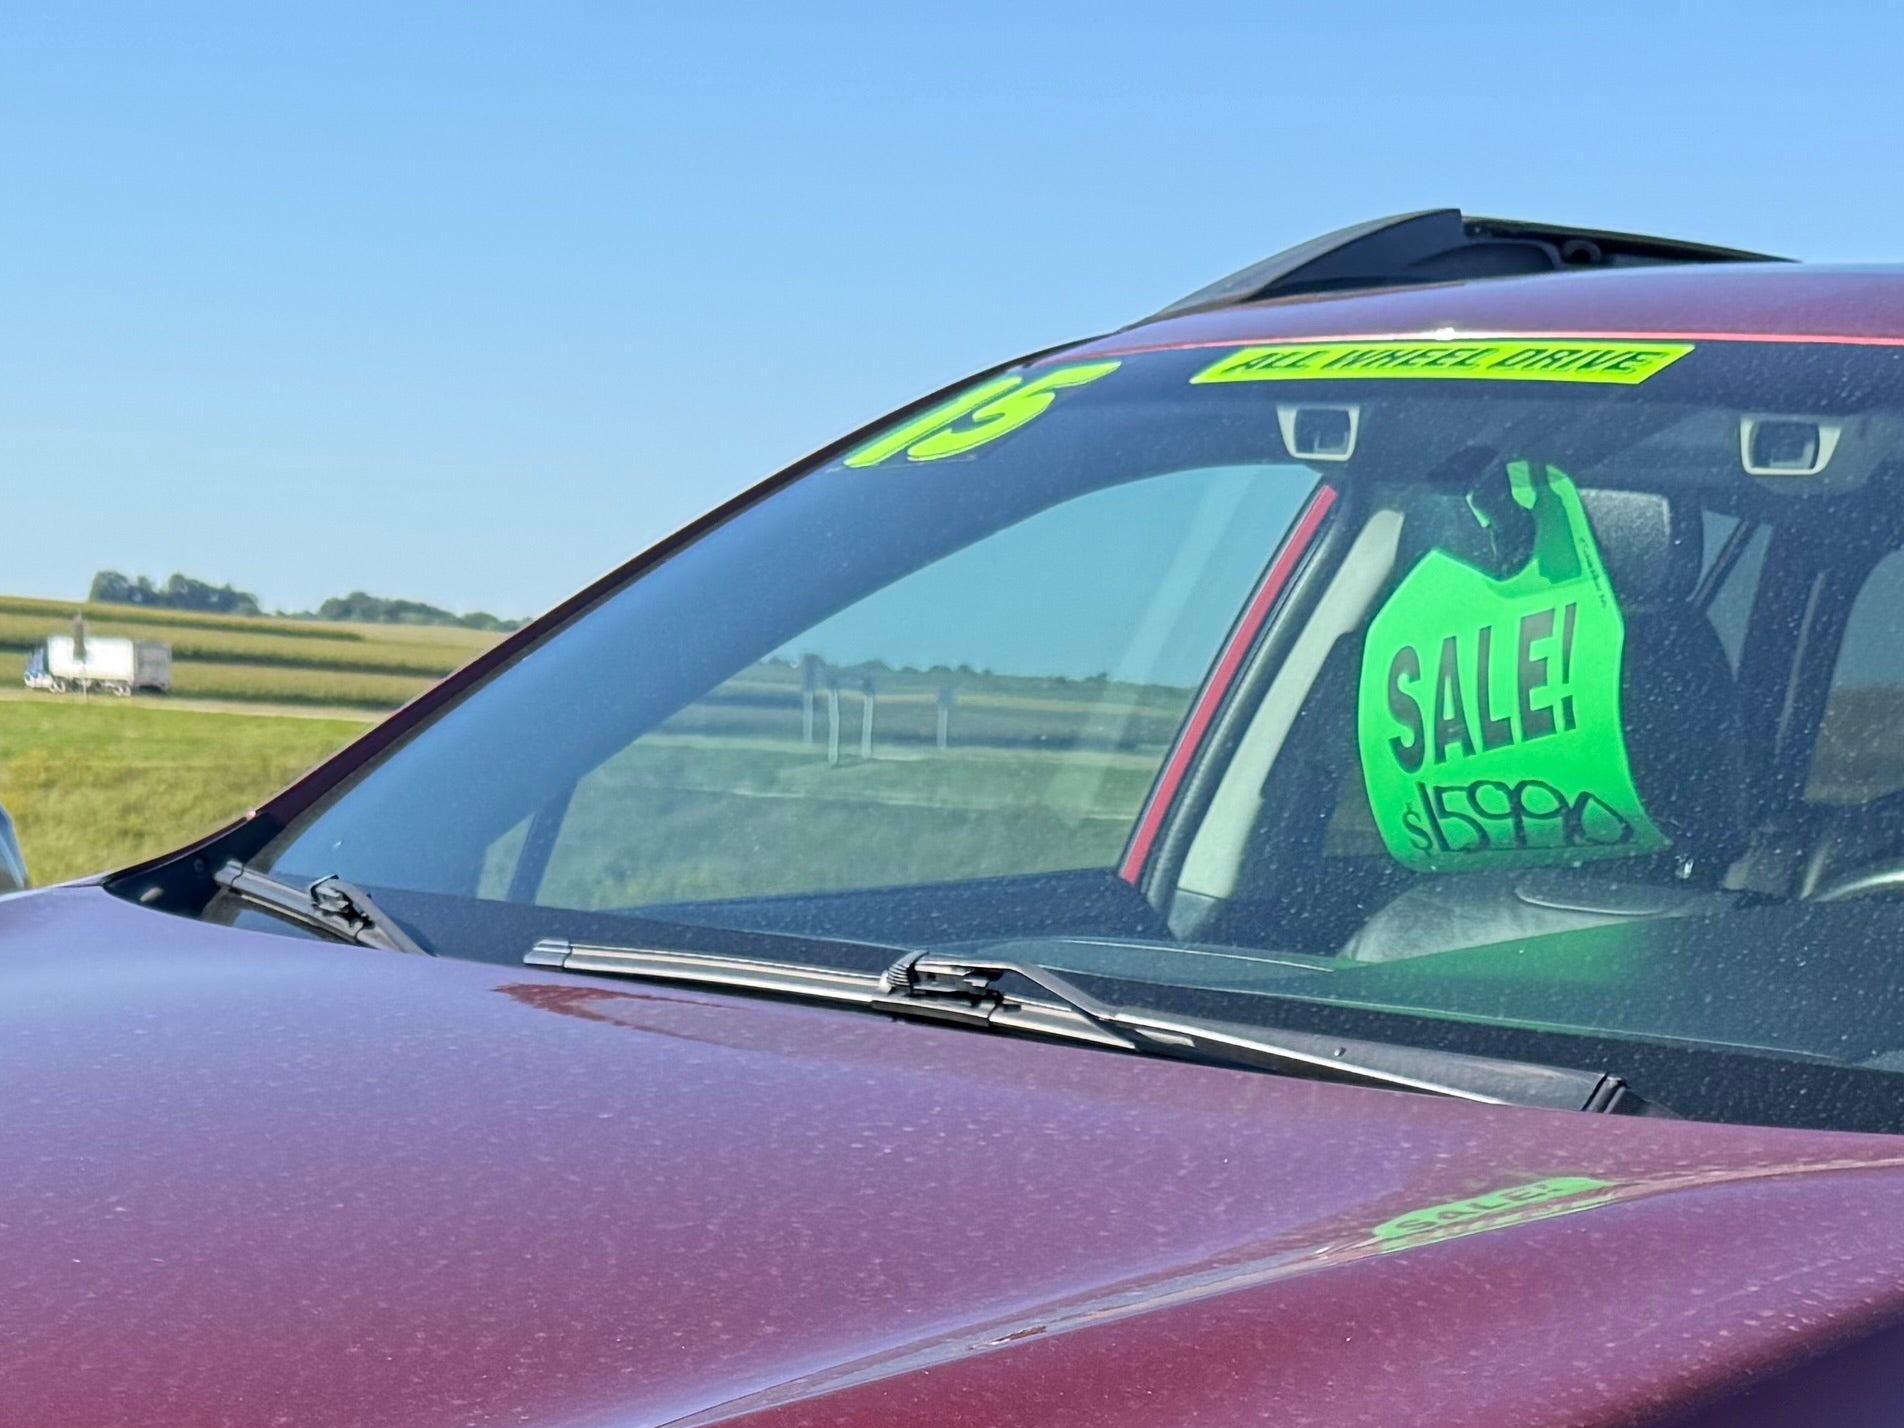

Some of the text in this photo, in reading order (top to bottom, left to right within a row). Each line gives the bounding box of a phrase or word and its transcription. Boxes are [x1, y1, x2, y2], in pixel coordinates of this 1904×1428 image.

[844, 360, 1122, 468] 15
[1221, 348, 1670, 375] ALL WHEEL DRIVE
[1388, 602, 1577, 774] SALE!
